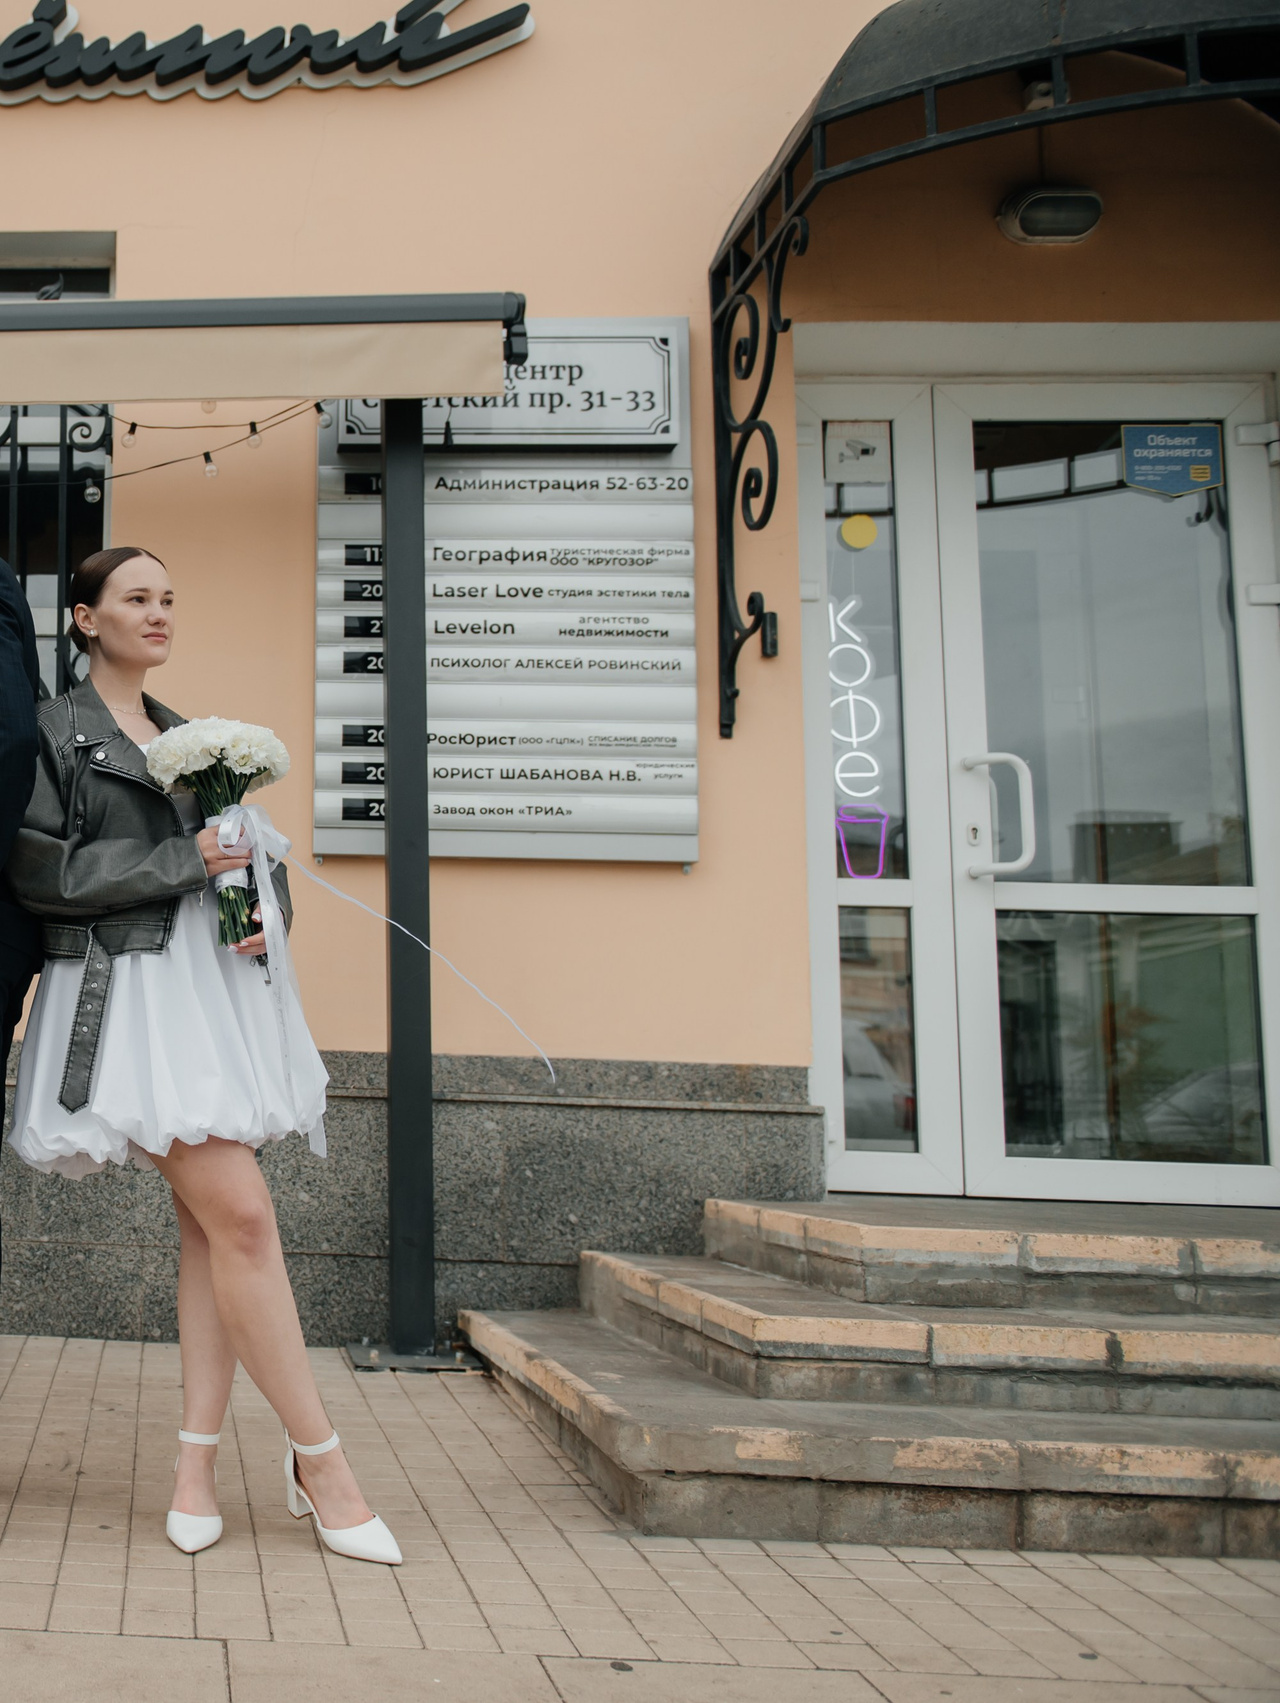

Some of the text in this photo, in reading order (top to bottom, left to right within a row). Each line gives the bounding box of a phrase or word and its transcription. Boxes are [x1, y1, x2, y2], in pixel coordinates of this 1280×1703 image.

[528, 392, 572, 414] пр.
[1146, 434, 1198, 446] Объект
[1133, 448, 1213, 459] охраняется
[434, 476, 689, 493] Администрация 52-63-20
[363, 547, 383, 563] 11
[432, 546, 548, 565] География
[549, 546, 690, 558] туристическая фирма
[549, 556, 659, 567] ООО "КРУГОЗОР"
[432, 583, 544, 598] Laser Love
[547, 588, 690, 599] студия эстетики тела
[433, 619, 516, 635] Levelon
[578, 616, 650, 625] агентство
[558, 627, 669, 638] недвижимости
[430, 657, 682, 671] ПСИХОЛОГ АЛЕКСЕЙ РОВИНСКИЙ
[426, 733, 516, 748] РосЮрист
[588, 735, 678, 744] СПИСАНИЕ ДОЛГОВ
[433, 767, 642, 782] ЮРИСТ ШАБАНОВА Н.В.
[433, 804, 573, 816] Завод окон «ТРИА»
